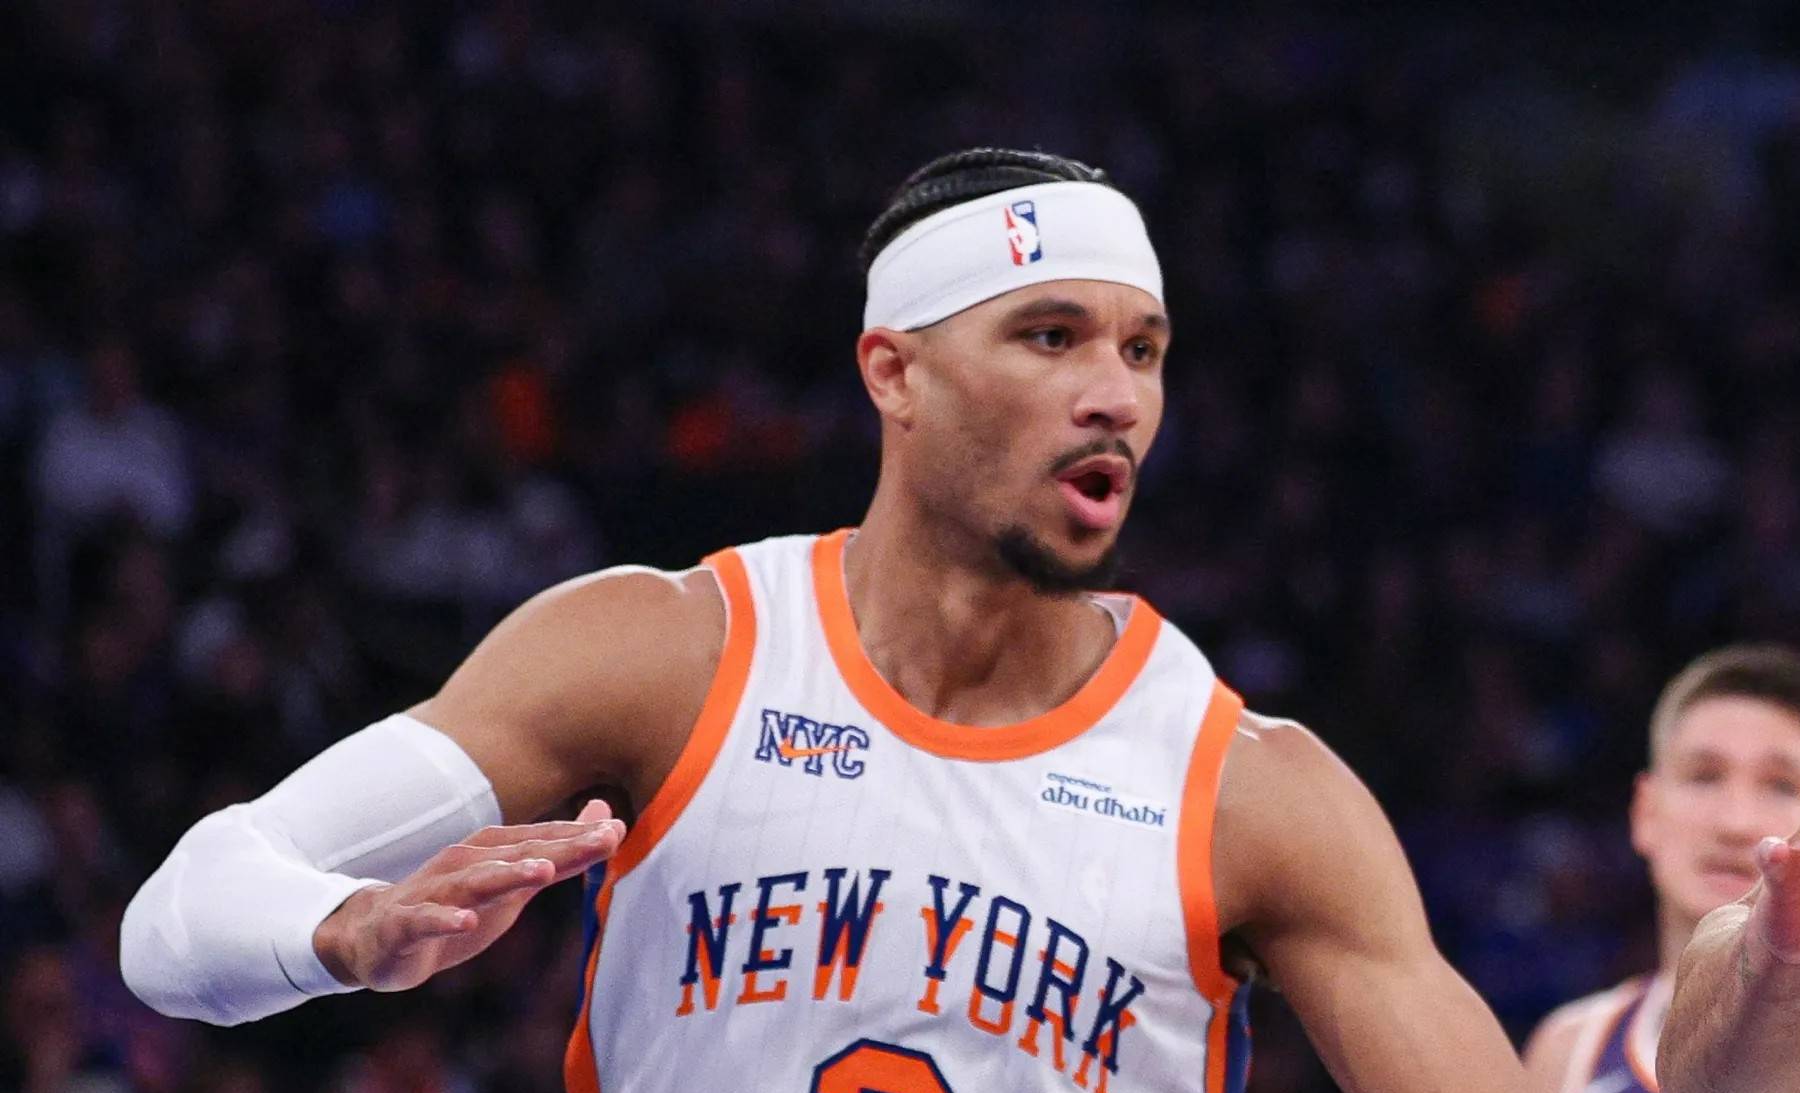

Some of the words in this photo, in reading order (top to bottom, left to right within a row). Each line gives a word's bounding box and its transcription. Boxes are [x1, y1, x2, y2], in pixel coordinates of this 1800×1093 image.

[754, 708, 871, 779] NYC
[1041, 785, 1088, 810] abu
[1093, 796, 1167, 827] dhabi
[675, 867, 892, 1017] NEW
